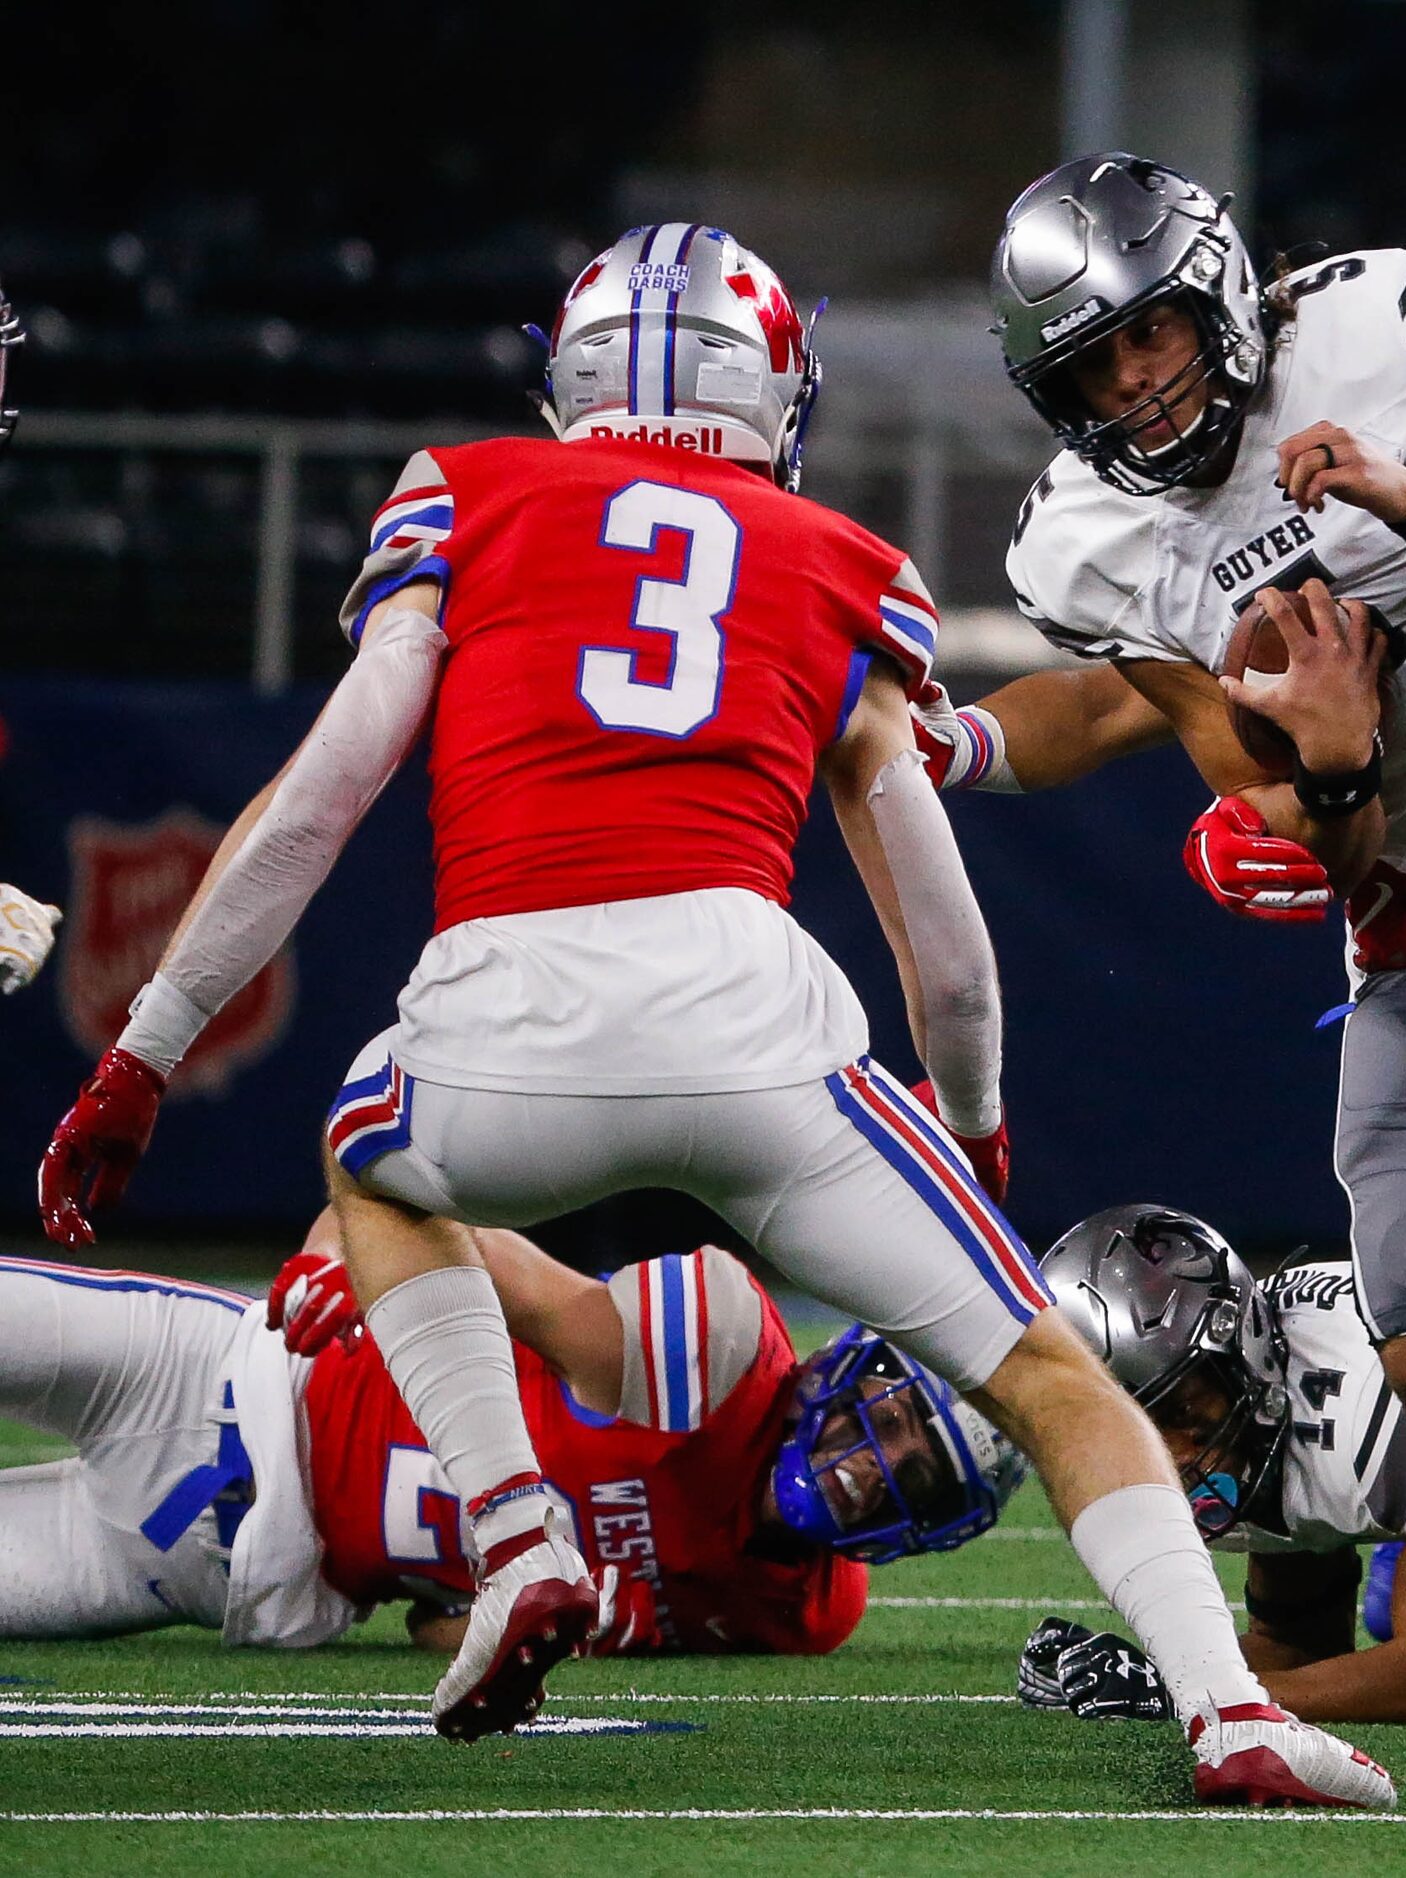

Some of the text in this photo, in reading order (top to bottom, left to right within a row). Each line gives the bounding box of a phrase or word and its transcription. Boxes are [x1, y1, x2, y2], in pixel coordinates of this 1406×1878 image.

[627, 275, 688, 293] DABBS
[630, 263, 690, 278] COACH
[1040, 299, 1101, 343] Riddell
[1211, 514, 1316, 593] GUYER
[575, 478, 745, 741] 3
[1294, 1367, 1347, 1452] 14
